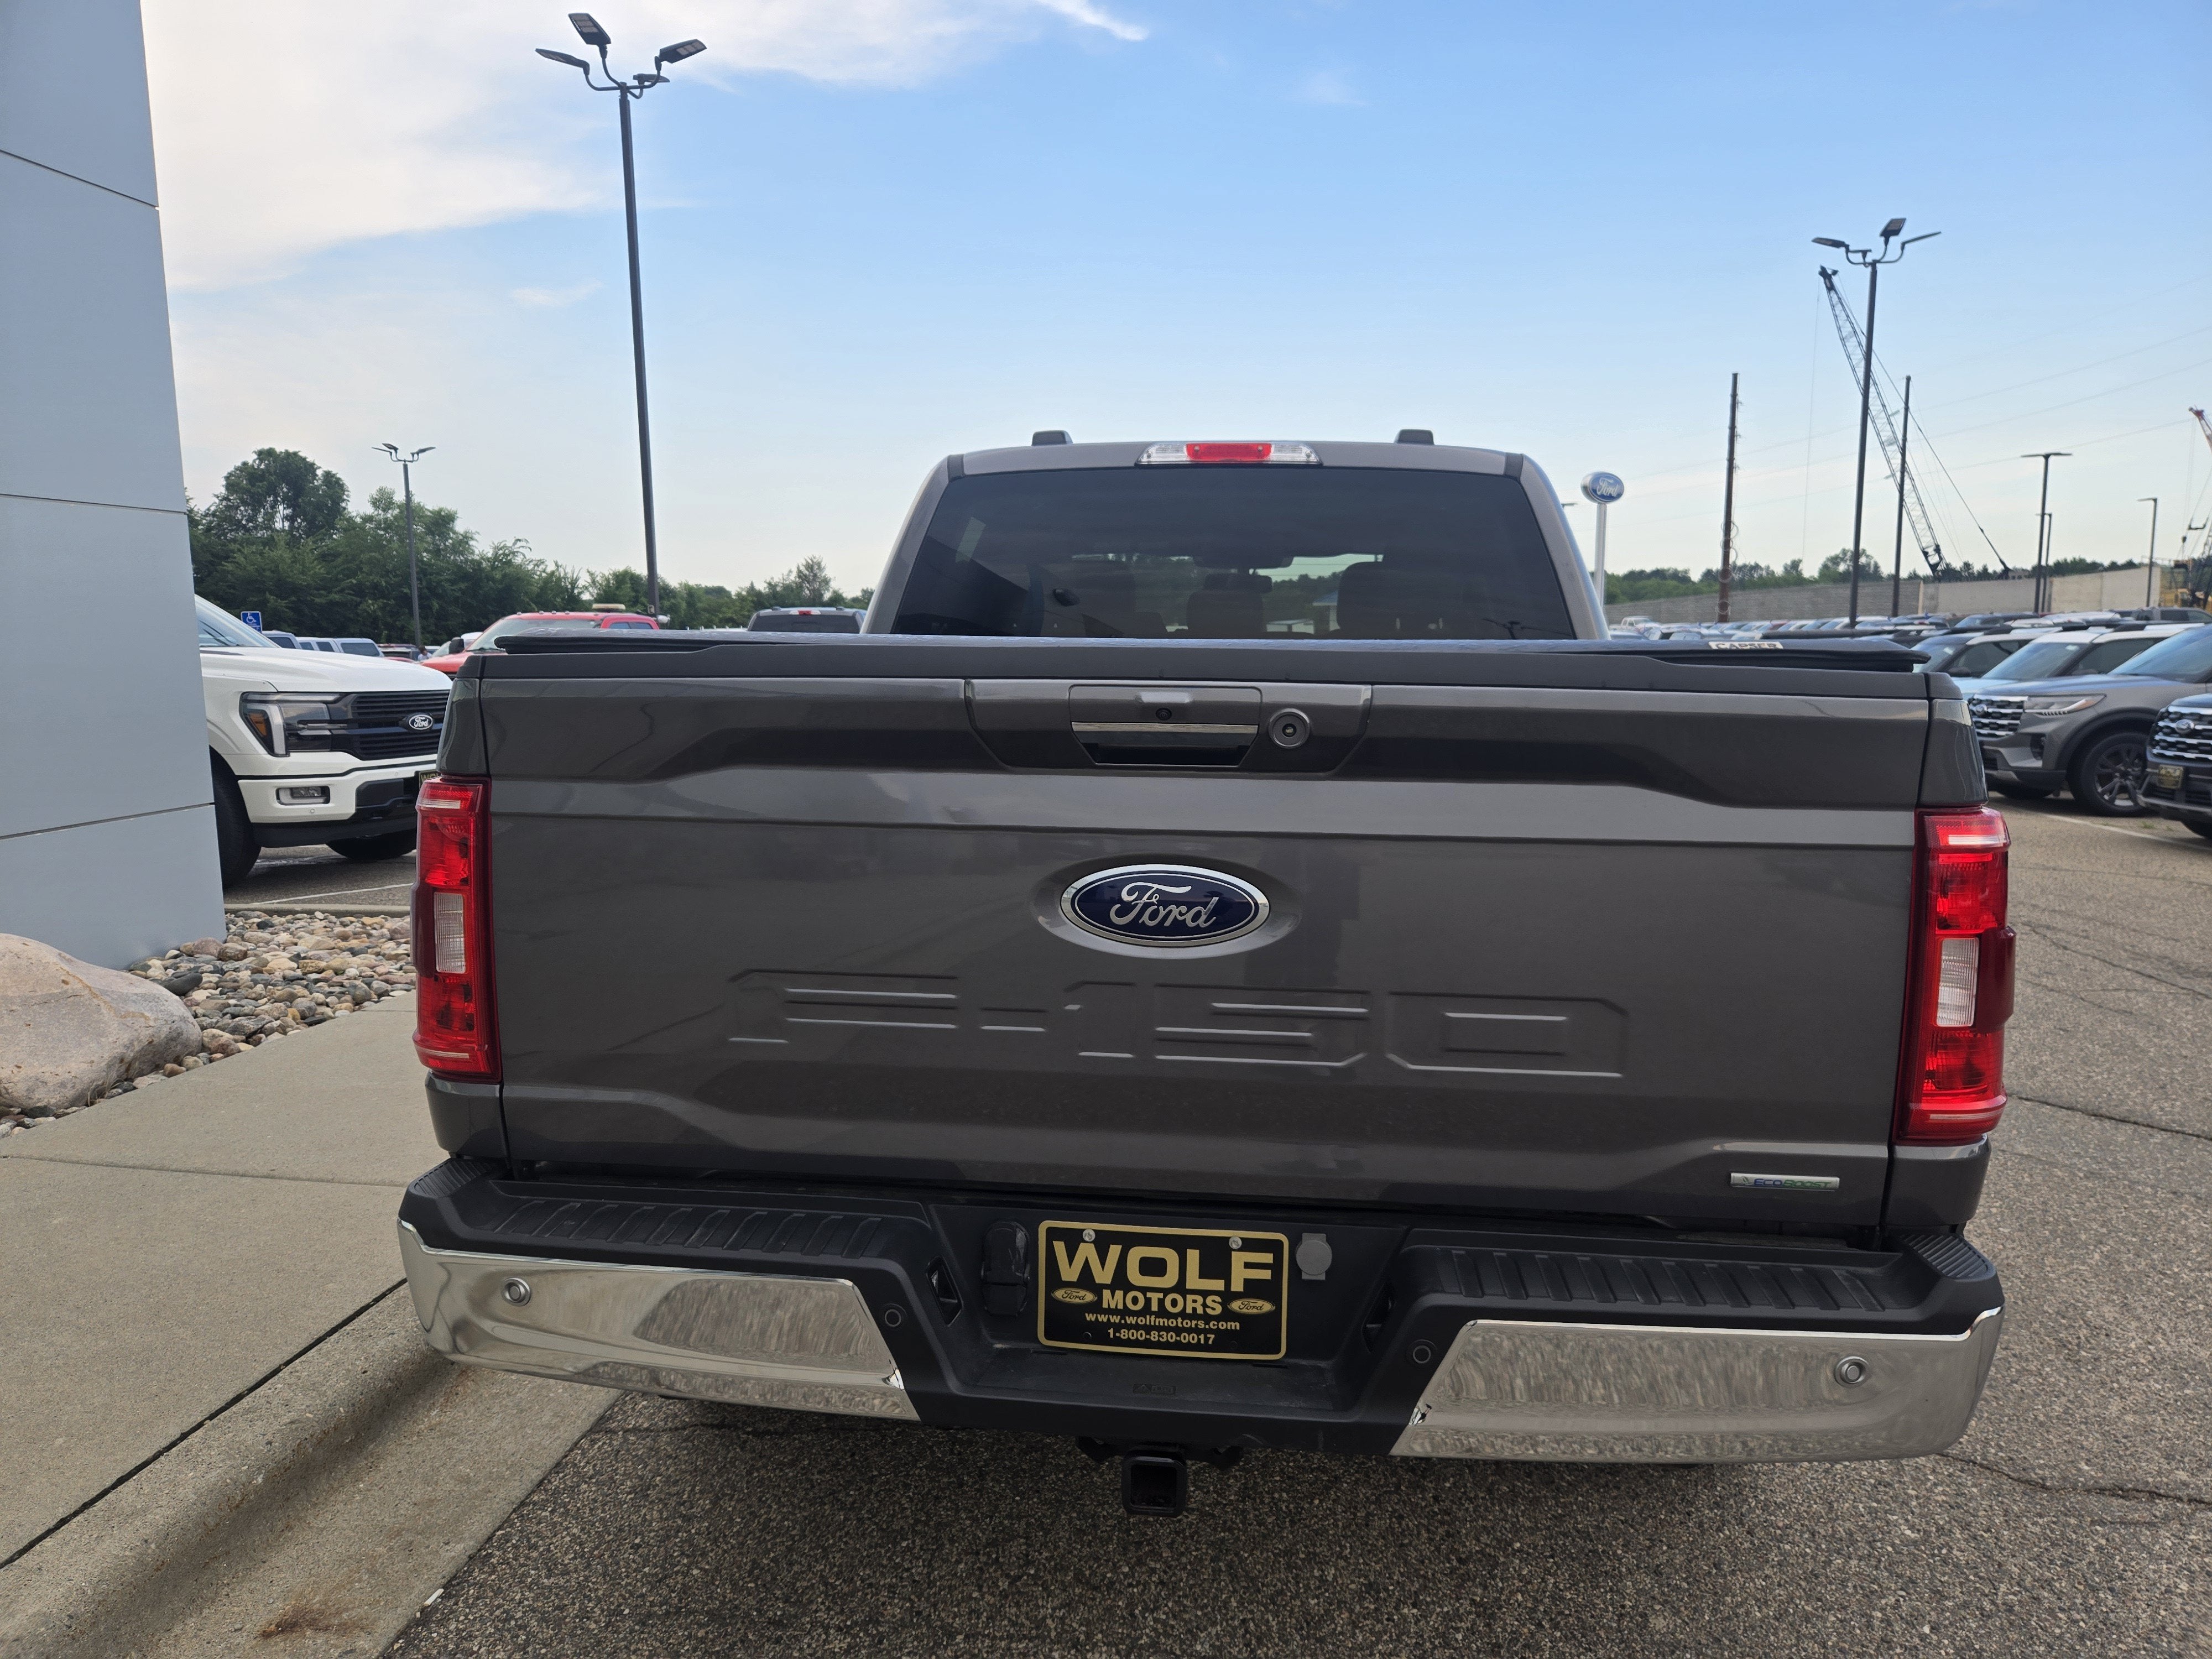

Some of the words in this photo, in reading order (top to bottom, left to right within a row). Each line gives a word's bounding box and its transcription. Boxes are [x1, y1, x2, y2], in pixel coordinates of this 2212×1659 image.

[1597, 477, 1618, 497] Ford
[414, 717, 429, 727] Ford
[1109, 881, 1219, 928] Ford
[1754, 1178, 1832, 1189] ECOBOOST
[1052, 1240, 1274, 1292] WOLF
[1061, 1290, 1087, 1301] Ford
[1102, 1289, 1222, 1315] MOTORS
[1238, 1301, 1264, 1311] Ford
[1085, 1313, 1240, 1330] www.wolfmotors.com
[1108, 1328, 1215, 1344] 1-800-830-0017
